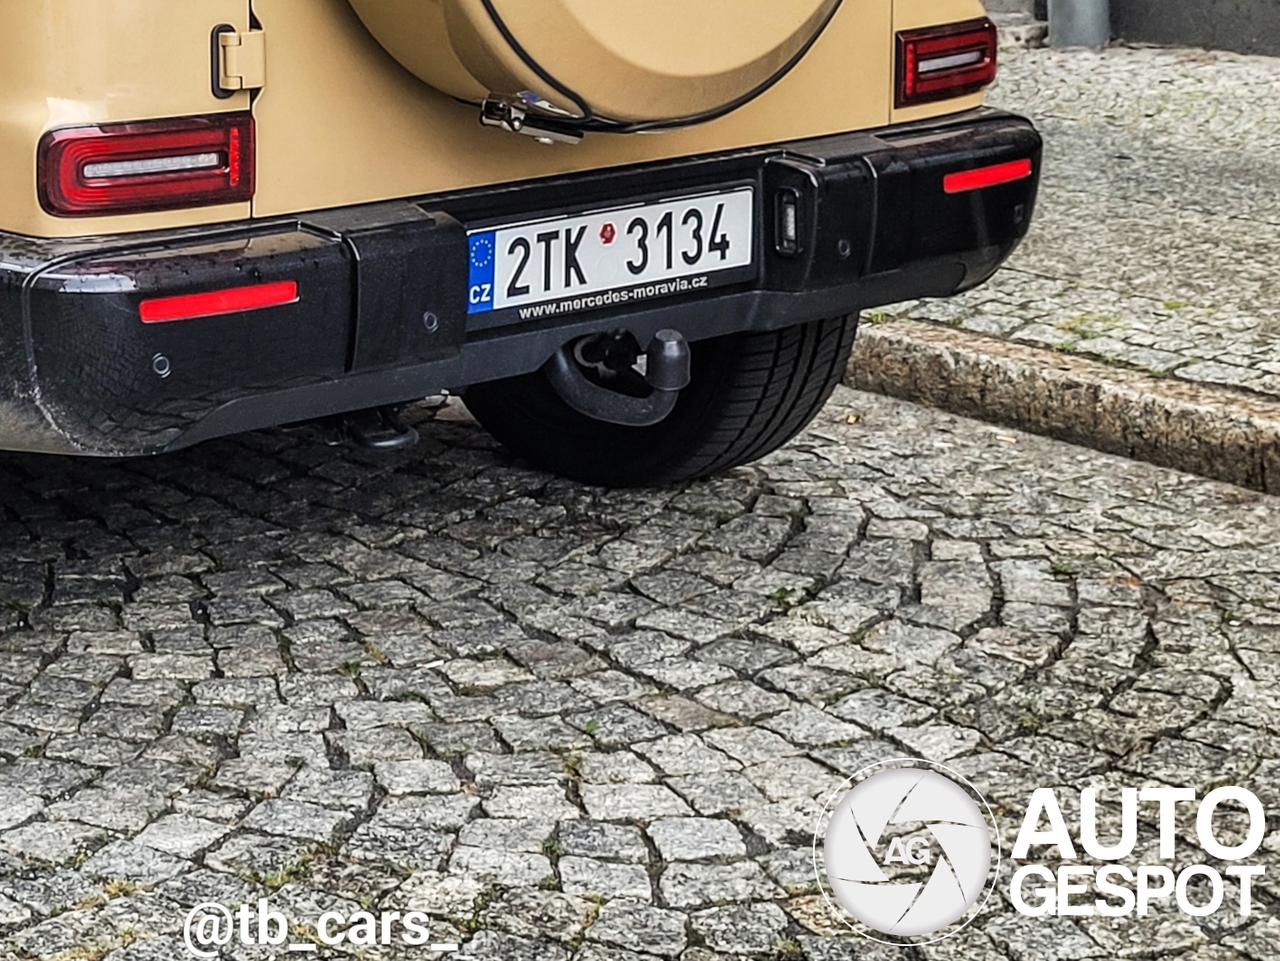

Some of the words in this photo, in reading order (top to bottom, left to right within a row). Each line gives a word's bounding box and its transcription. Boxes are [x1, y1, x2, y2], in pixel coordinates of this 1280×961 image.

[506, 224, 589, 299] 2TK
[625, 202, 730, 276] 3134
[469, 282, 492, 305] CZ
[519, 275, 708, 320] www.mercedes-moravia.cz
